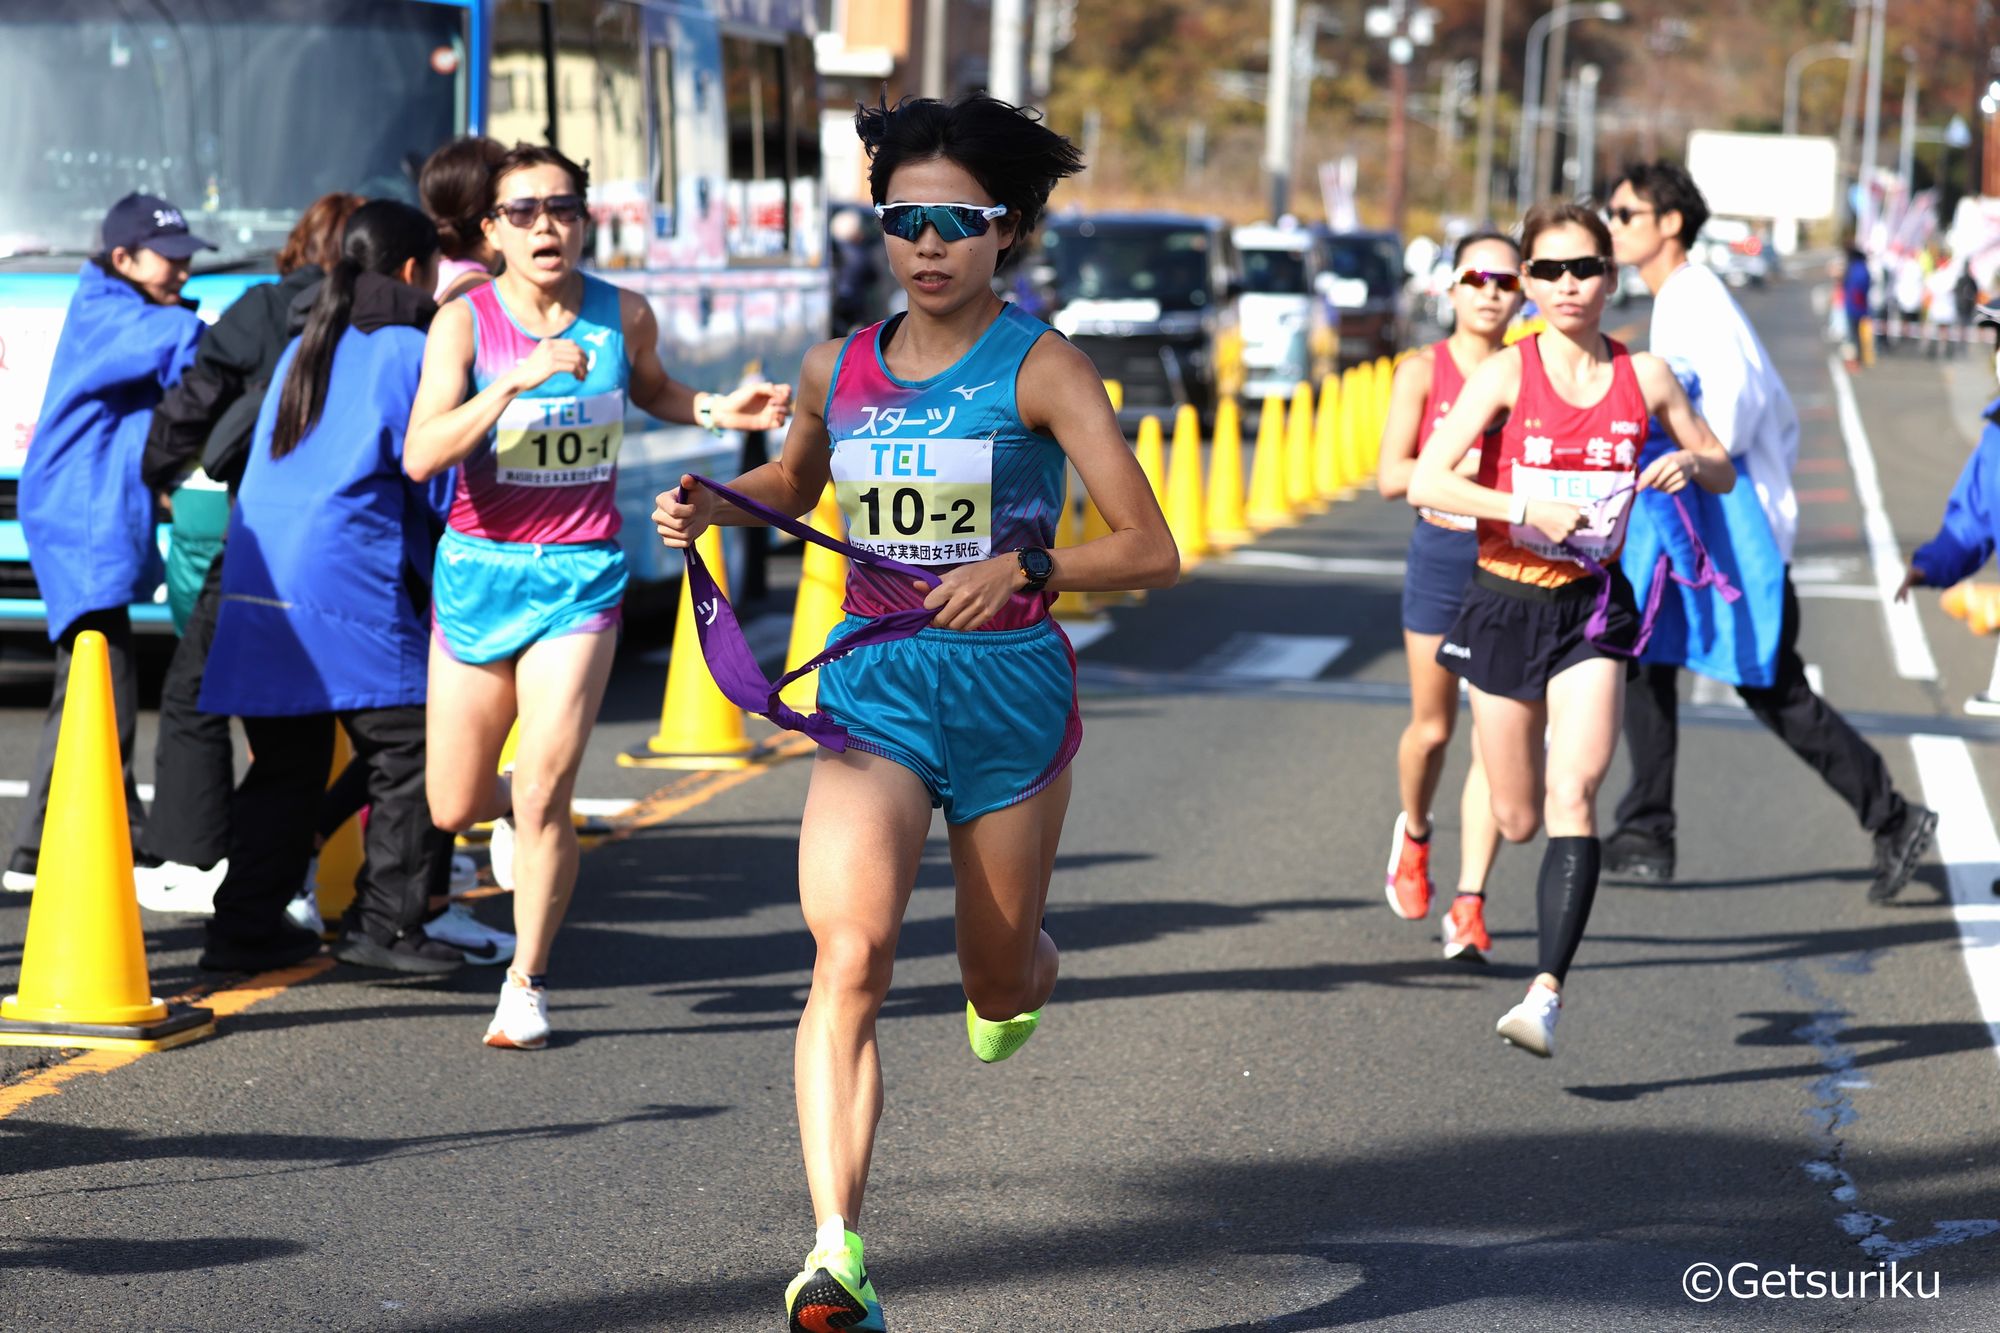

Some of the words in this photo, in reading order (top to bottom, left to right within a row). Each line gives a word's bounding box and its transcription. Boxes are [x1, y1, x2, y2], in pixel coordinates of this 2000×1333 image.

[540, 402, 593, 426] TEL
[852, 406, 956, 436] スターツ
[531, 431, 609, 467] 10-1
[870, 443, 937, 477] TEL
[1549, 476, 1601, 499] TEL
[859, 487, 976, 536] 10-2
